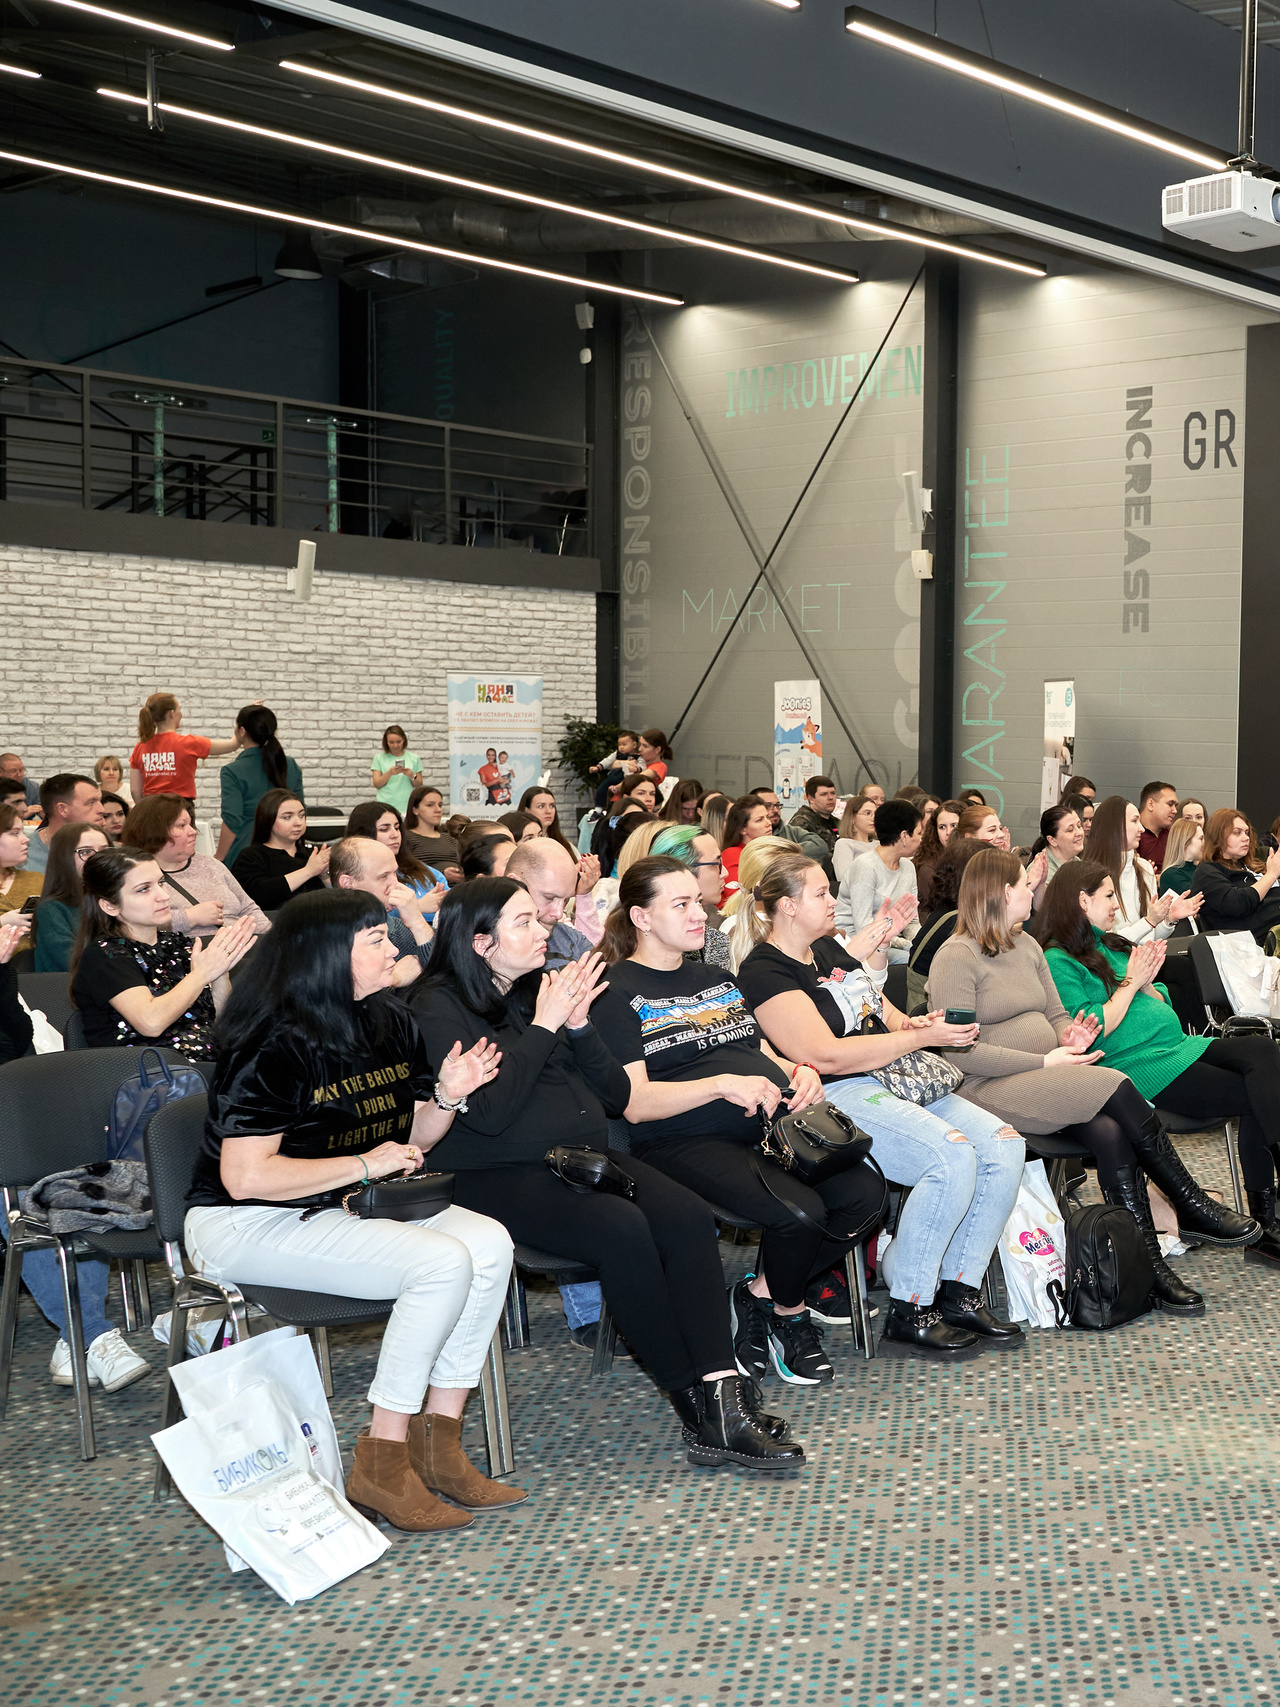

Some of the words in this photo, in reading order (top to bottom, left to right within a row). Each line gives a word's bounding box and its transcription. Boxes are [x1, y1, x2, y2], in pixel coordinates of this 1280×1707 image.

[434, 307, 455, 420] QUALITY
[1182, 408, 1238, 471] GR
[1122, 385, 1153, 634] INCREASE
[682, 582, 852, 634] MARKET
[477, 684, 514, 695] НЯНЯ
[696, 1037, 708, 1051] IS
[709, 1025, 755, 1046] COMING
[313, 1084, 341, 1106] MAY
[341, 1075, 366, 1097] THE
[355, 1104, 362, 1119] I
[364, 1092, 397, 1116] BURN
[327, 1125, 368, 1150] LIGHT
[371, 1118, 393, 1140] THE
[213, 1444, 288, 1492] БИБИКОЛЬ
